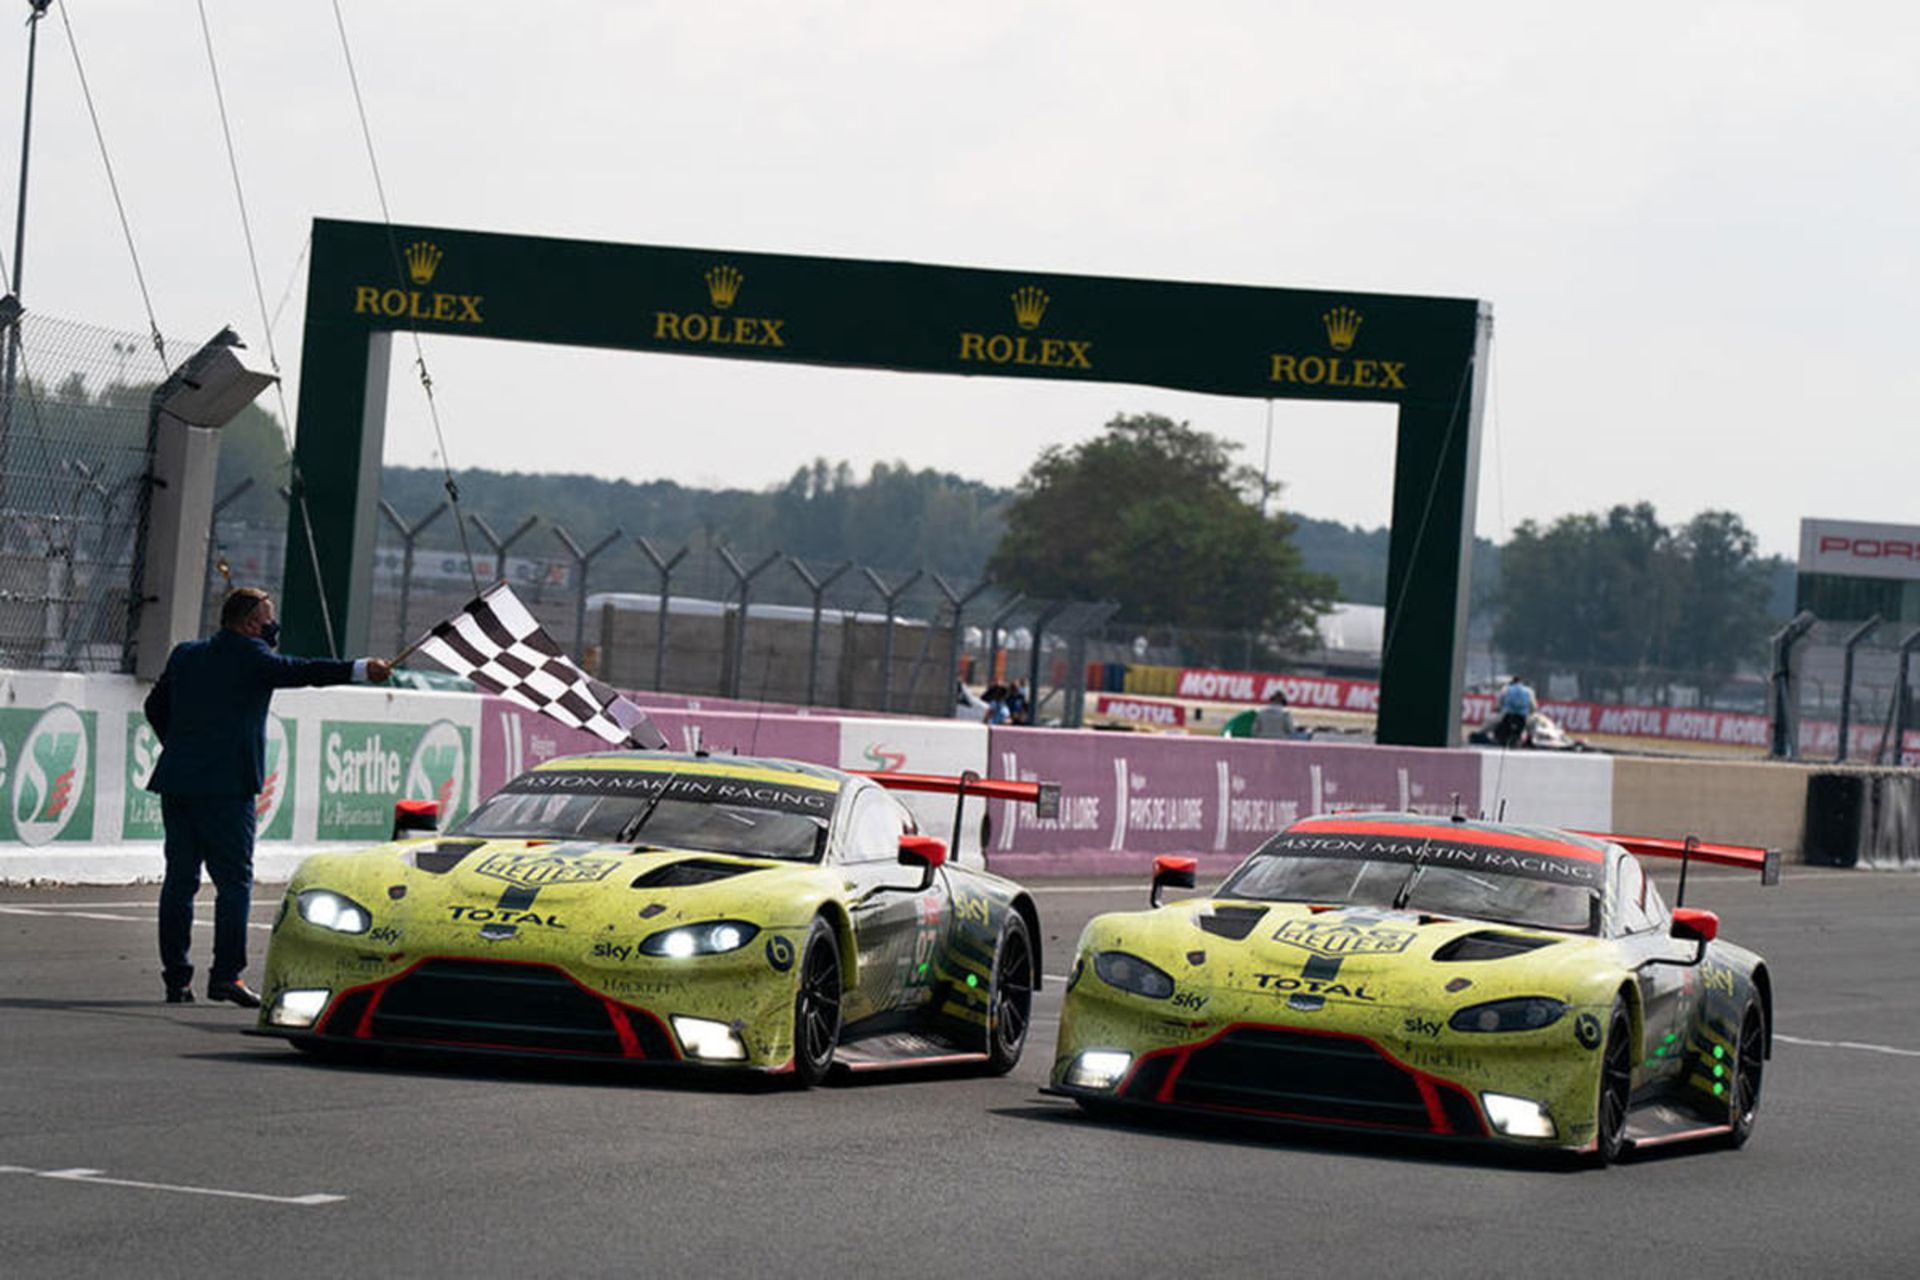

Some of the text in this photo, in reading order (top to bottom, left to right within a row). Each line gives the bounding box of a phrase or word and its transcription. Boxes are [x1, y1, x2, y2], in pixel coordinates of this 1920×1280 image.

[353, 286, 483, 324] ROLEX
[653, 311, 786, 348] ROLEX
[958, 331, 1093, 370] ROLEX
[1269, 353, 1407, 391] ROLEX
[1179, 672, 1255, 699] MOTUL
[1107, 701, 1176, 724] MOTUL
[1601, 708, 1660, 734] MOTUL
[326, 732, 400, 794] Sarthe
[516, 774, 826, 809] ASTON MARTIN RACING
[1276, 838, 1596, 879] ASTON MARTIN RACING
[448, 905, 568, 929] TOTAL
[955, 892, 989, 928] sky
[369, 926, 403, 946] sky
[593, 942, 632, 961] sky
[1253, 973, 1376, 1001] TOTAL
[1172, 992, 1209, 1012] sky
[1404, 1017, 1443, 1037] sky
